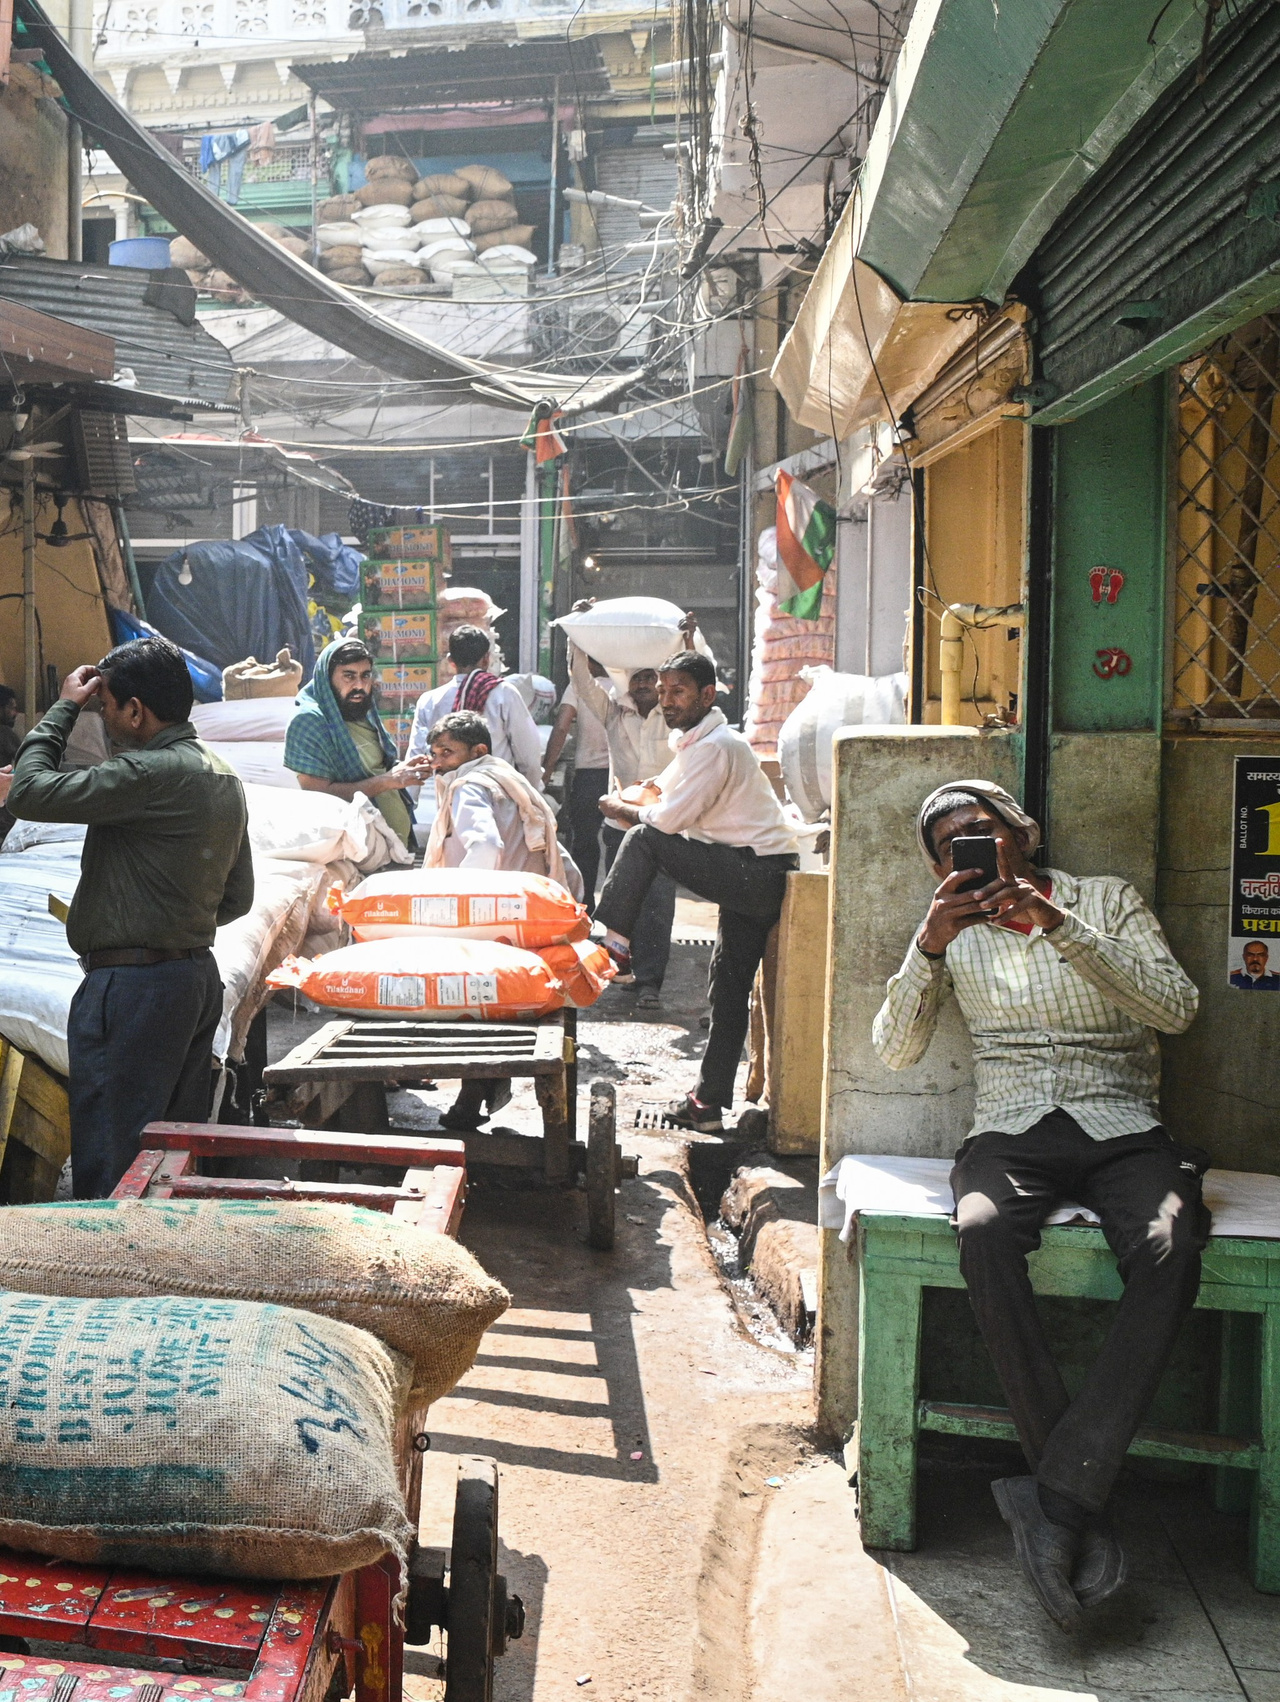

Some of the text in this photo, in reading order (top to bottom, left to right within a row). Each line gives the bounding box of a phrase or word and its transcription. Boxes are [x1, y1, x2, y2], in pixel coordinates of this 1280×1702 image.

[1240, 805, 1248, 818] NO.
[326, 985, 365, 994] Tilakdhari
[58, 1350, 98, 1442] BEST
